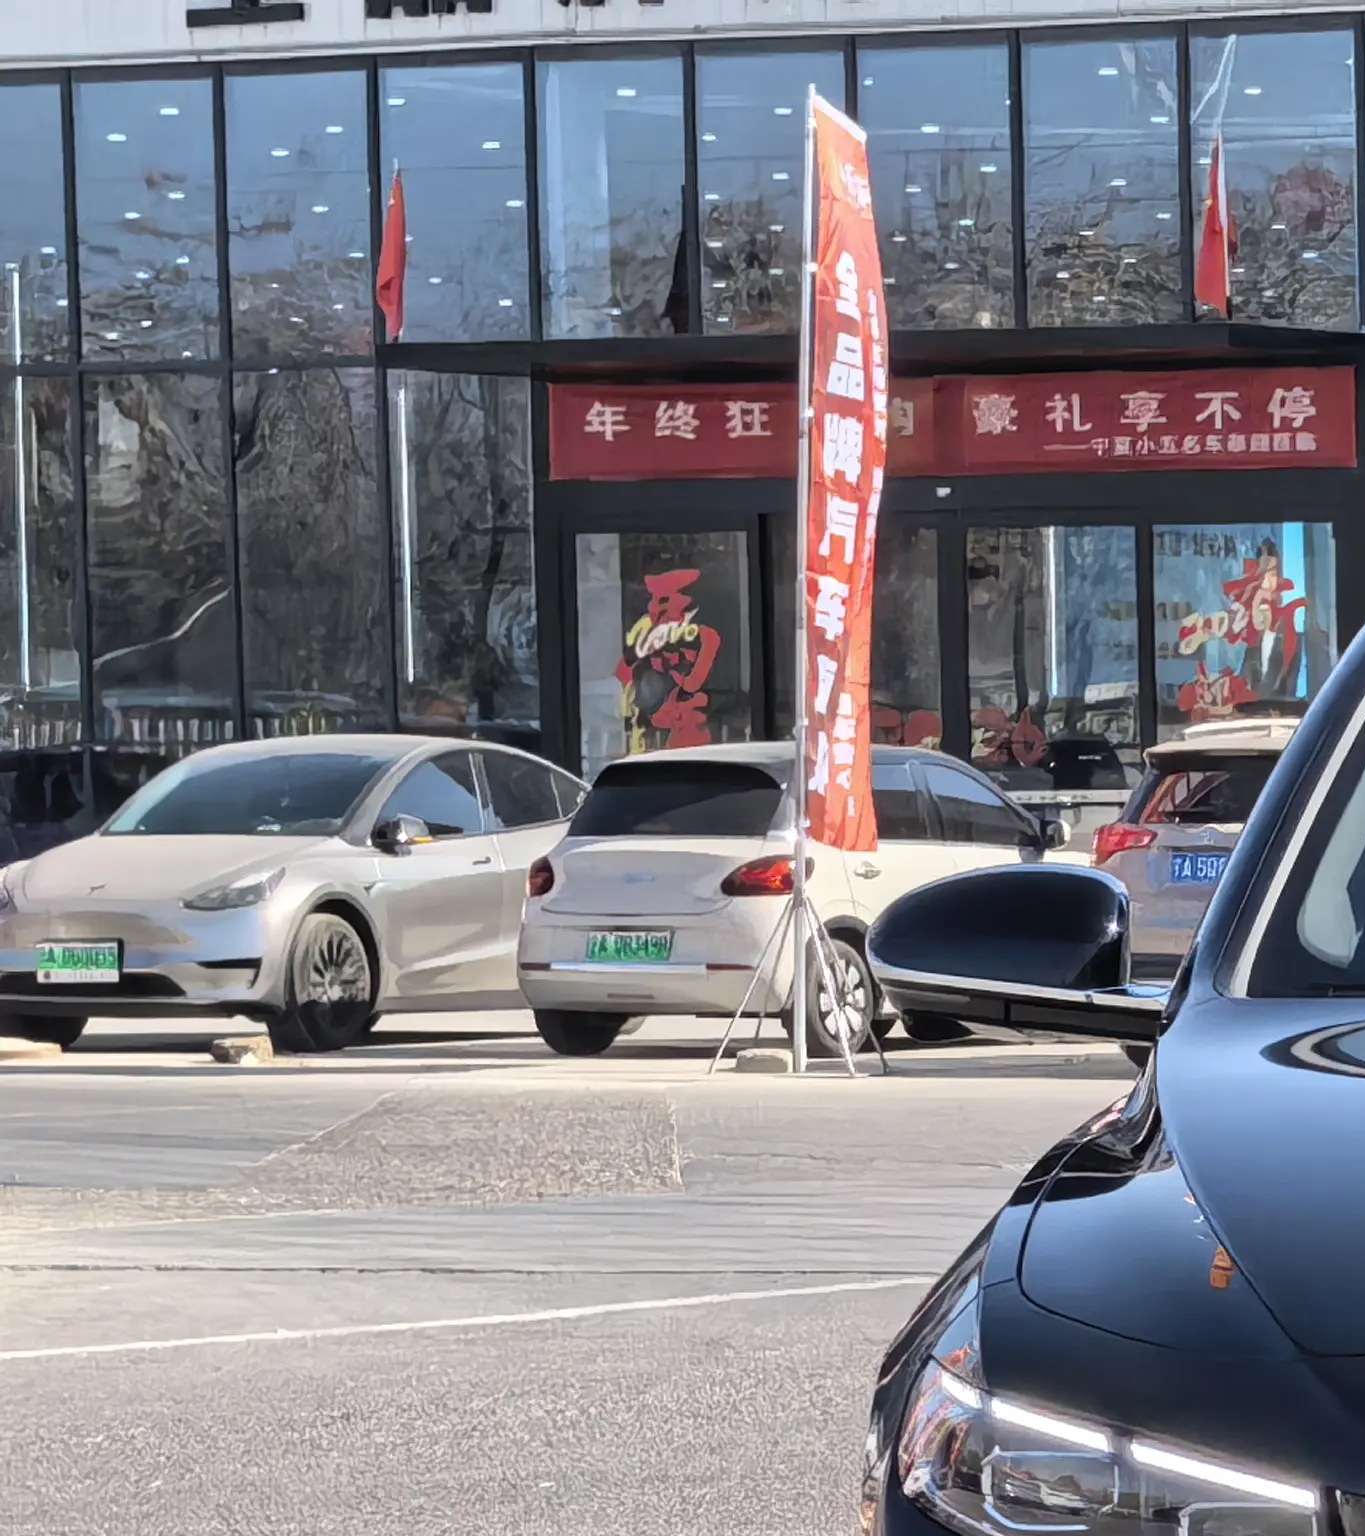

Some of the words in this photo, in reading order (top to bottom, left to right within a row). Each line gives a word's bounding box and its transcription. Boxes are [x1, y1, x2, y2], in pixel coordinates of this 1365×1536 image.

[584, 399, 914, 442] 年终狂
[972, 386, 1318, 436] 豪礼享不停
